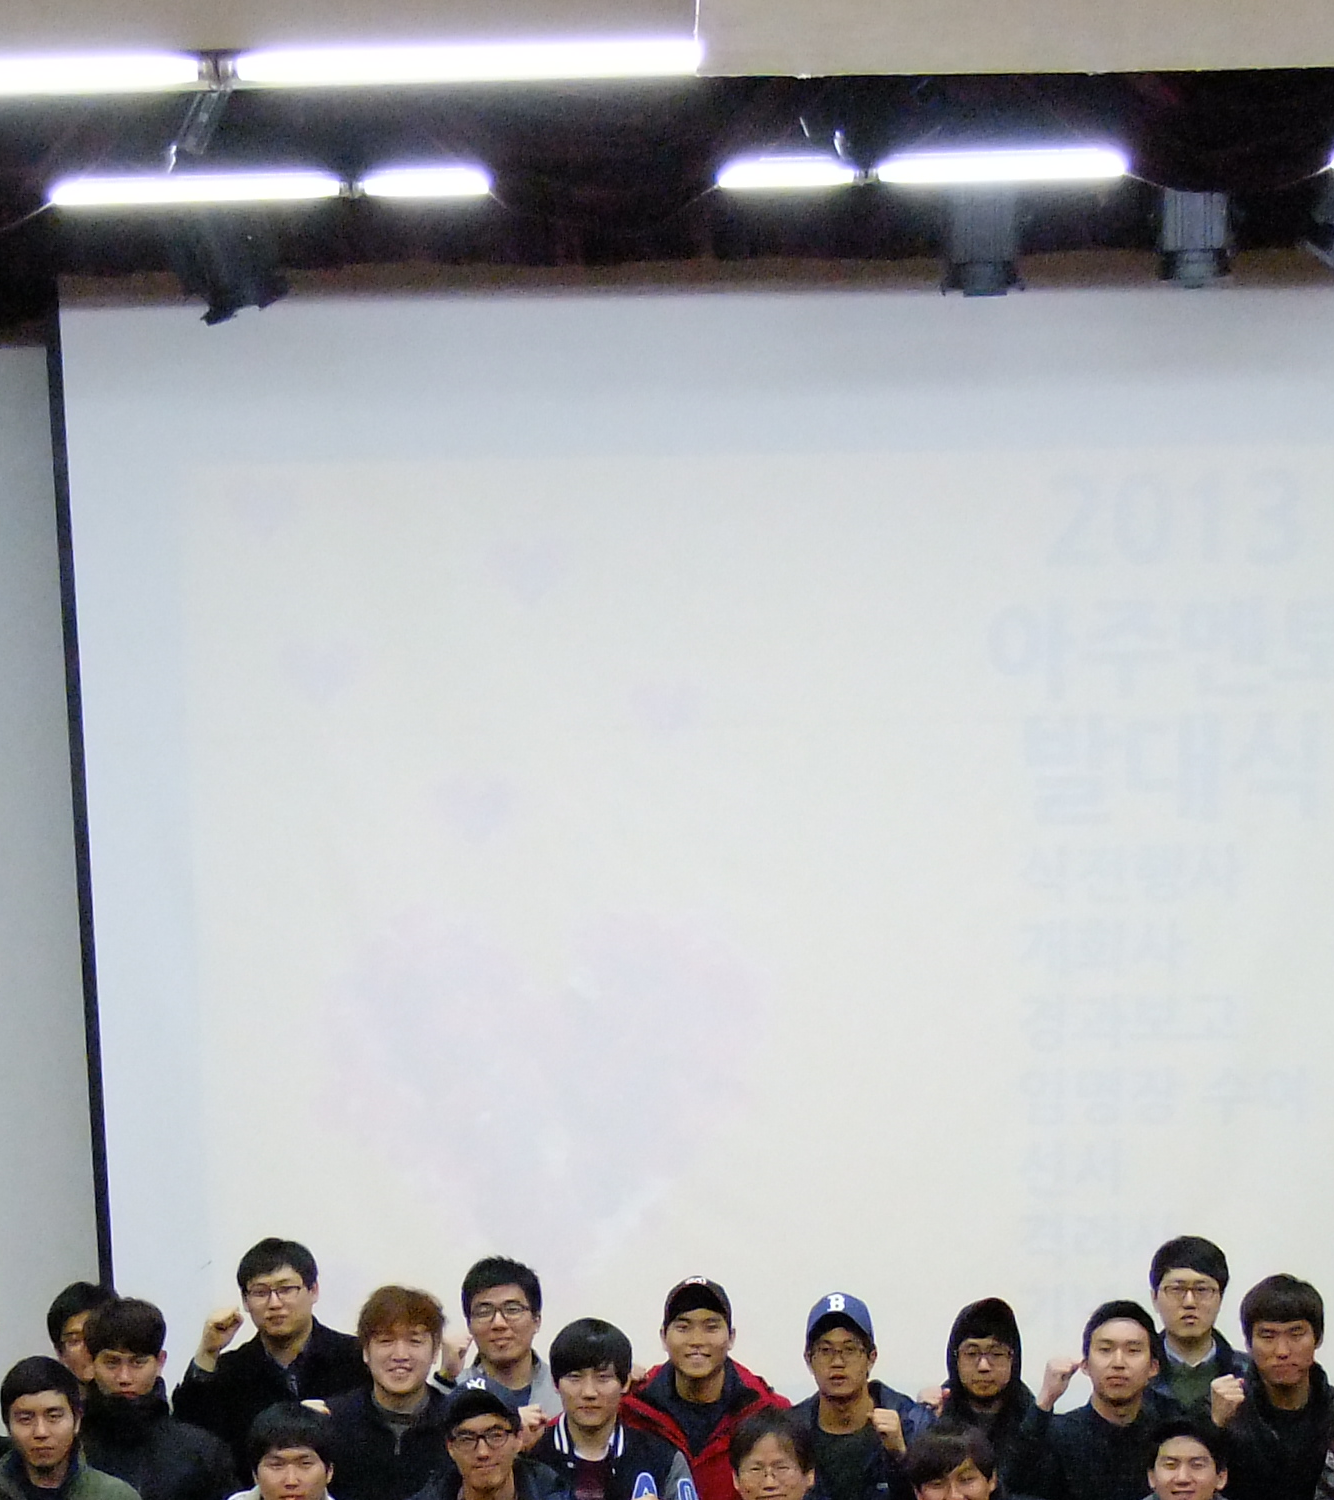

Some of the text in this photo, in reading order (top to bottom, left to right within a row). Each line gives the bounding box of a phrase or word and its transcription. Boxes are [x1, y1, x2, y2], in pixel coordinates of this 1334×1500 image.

[1045, 467, 1305, 567] 2013
[1023, 709, 1320, 826] 발대식
[1017, 840, 1244, 905] 식전행사
[1017, 919, 1192, 977] 개회사
[1017, 990, 1241, 1054] 경과보고
[1017, 1064, 1311, 1128] 임명장 수여
[827, 1293, 846, 1312] B
